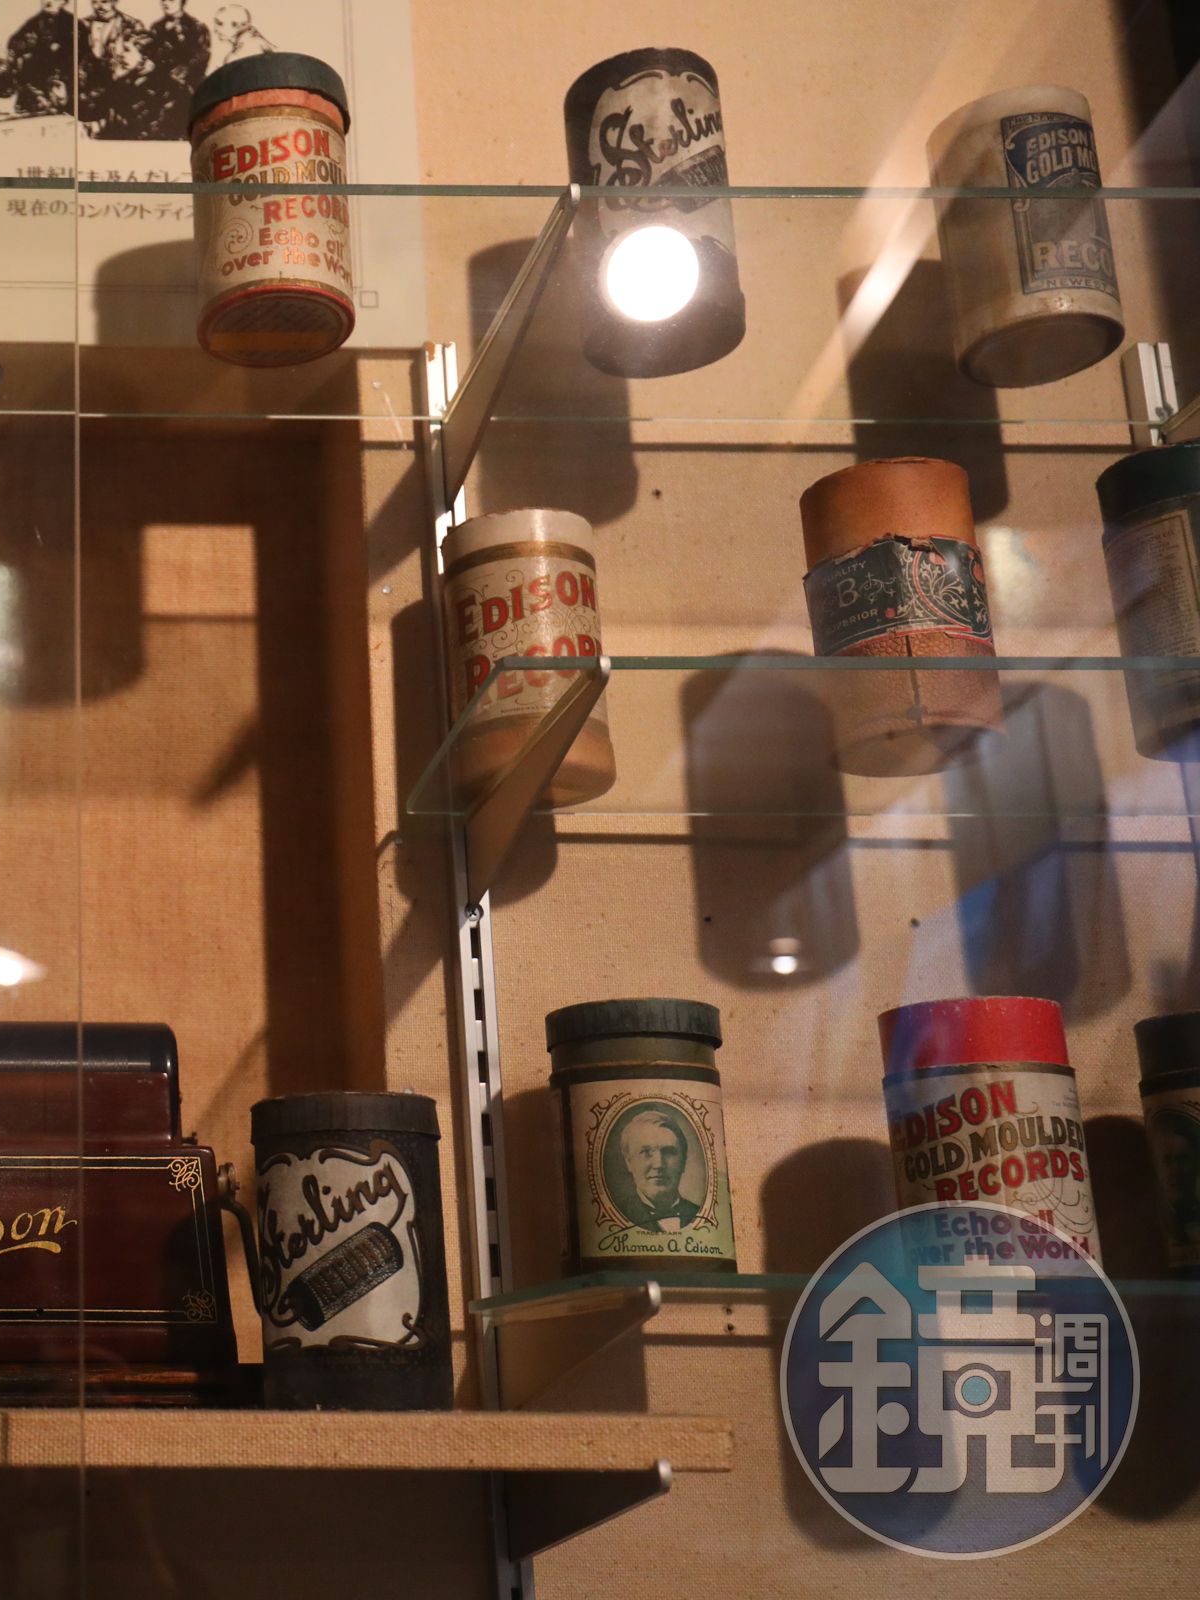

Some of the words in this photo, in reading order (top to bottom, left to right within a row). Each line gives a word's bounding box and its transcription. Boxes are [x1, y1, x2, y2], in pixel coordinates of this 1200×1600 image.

[212, 128, 330, 183] EDISON
[1025, 127, 1087, 158] EDISON
[1025, 147, 1073, 184] GOLD
[258, 226, 320, 248] Echo
[220, 250, 274, 276] over
[282, 246, 321, 268] the
[455, 571, 598, 645] EDISON
[904, 1142, 965, 1183] GOLD
[968, 1116, 1087, 1164] MOULDED
[934, 1150, 1085, 1207] RECORDS
[935, 1211, 1012, 1238] Echo
[1019, 1209, 1055, 1235] all
[598, 1231, 664, 1253] Thomas
[667, 1239, 681, 1252] A
[685, 1236, 723, 1255] Edison
[964, 1236, 1016, 1260] the
